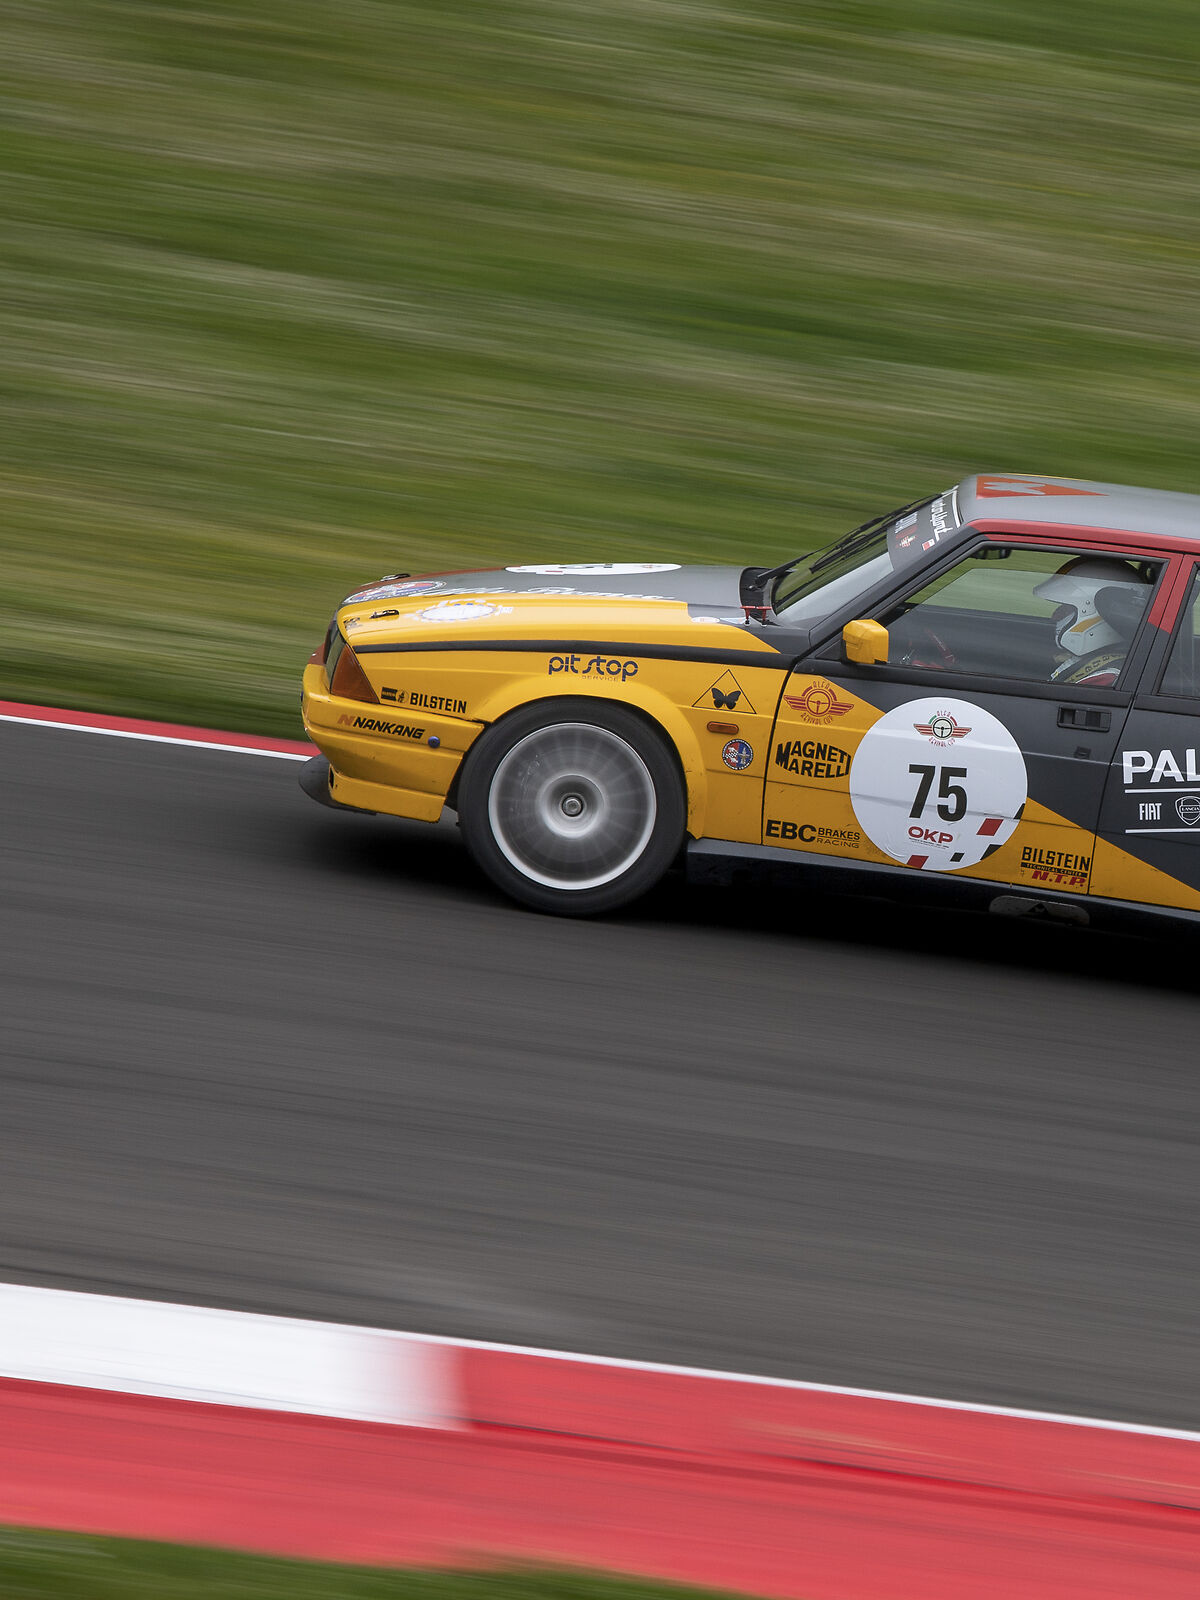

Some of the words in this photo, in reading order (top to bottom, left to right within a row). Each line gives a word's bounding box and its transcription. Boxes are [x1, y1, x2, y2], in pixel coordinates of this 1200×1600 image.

[548, 654, 581, 675] pit
[582, 656, 639, 682] stop
[410, 692, 467, 714] BILSTEIN
[352, 716, 426, 739] NANKANG
[775, 741, 852, 766] MAGNETI
[775, 758, 852, 779] MARELLI
[909, 764, 968, 822] 75
[1139, 802, 1162, 821] FIAT
[765, 819, 817, 843] EBC
[818, 827, 861, 841] BRAKES
[908, 826, 954, 844] OKP
[816, 838, 860, 849] RACING
[1021, 846, 1091, 872] BILSTEIN
